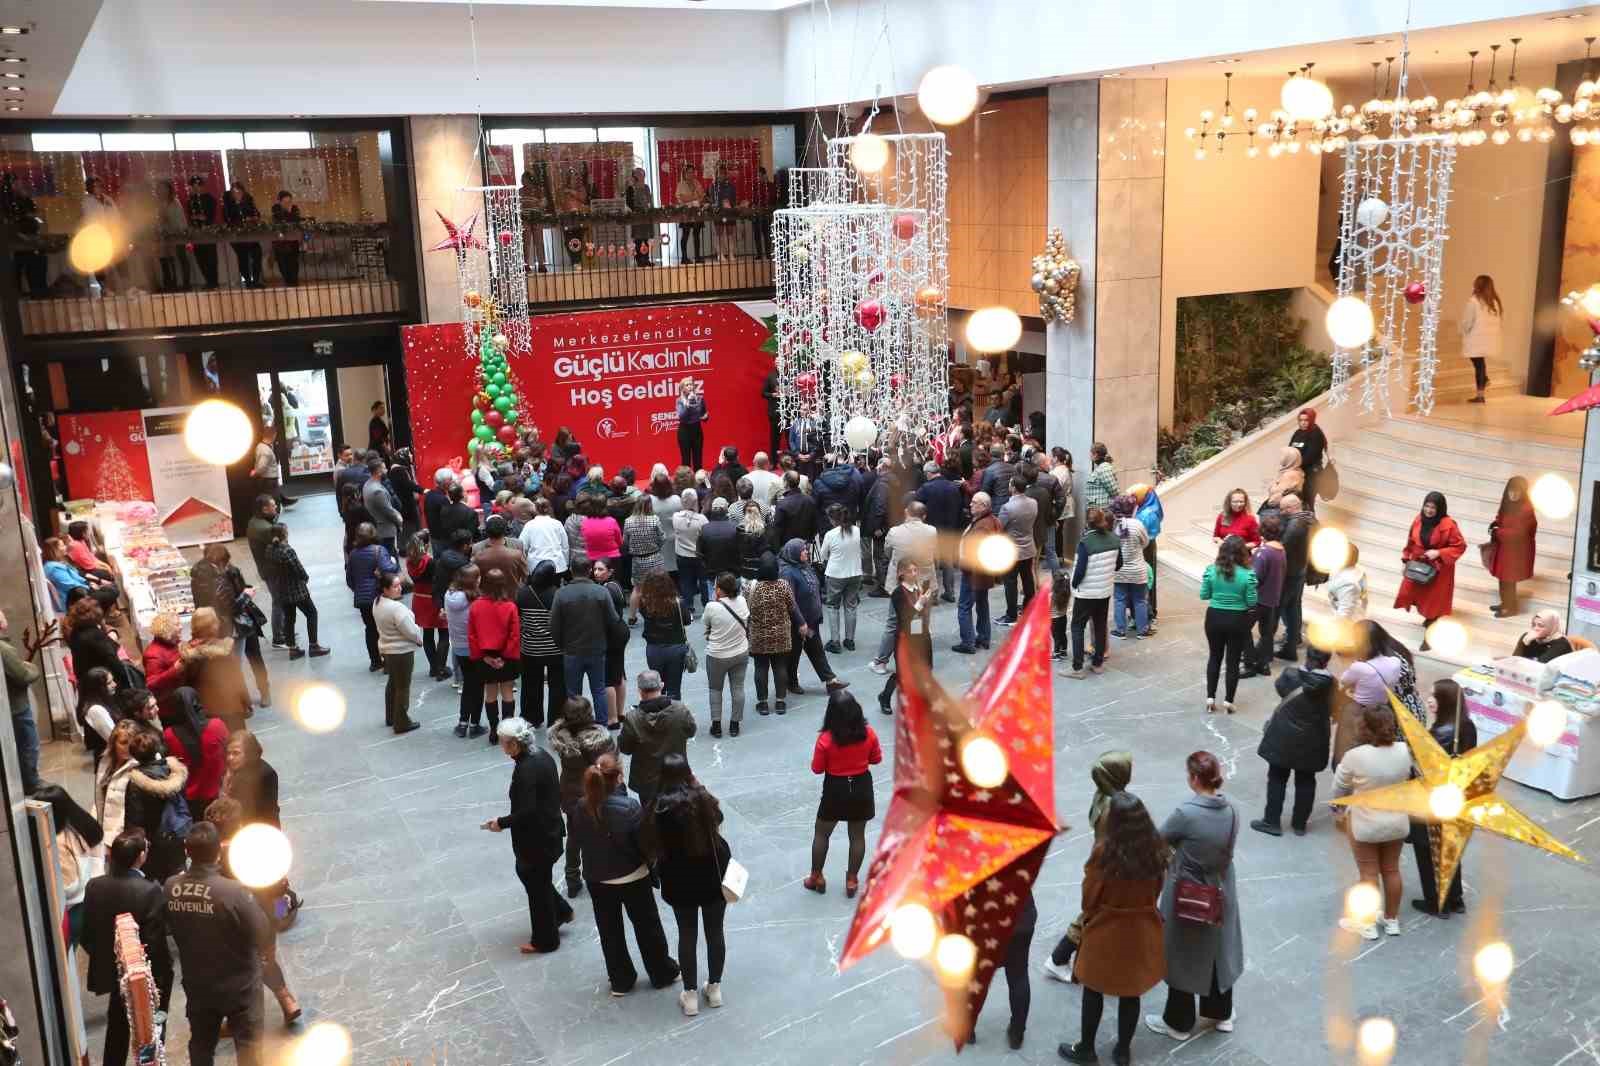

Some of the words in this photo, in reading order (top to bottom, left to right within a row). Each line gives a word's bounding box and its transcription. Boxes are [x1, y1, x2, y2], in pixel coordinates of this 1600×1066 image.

[554, 351, 624, 381] Güçlü
[628, 346, 712, 371] Kadınlar
[571, 387, 612, 408] Hoş
[617, 378, 704, 400] Geldiz
